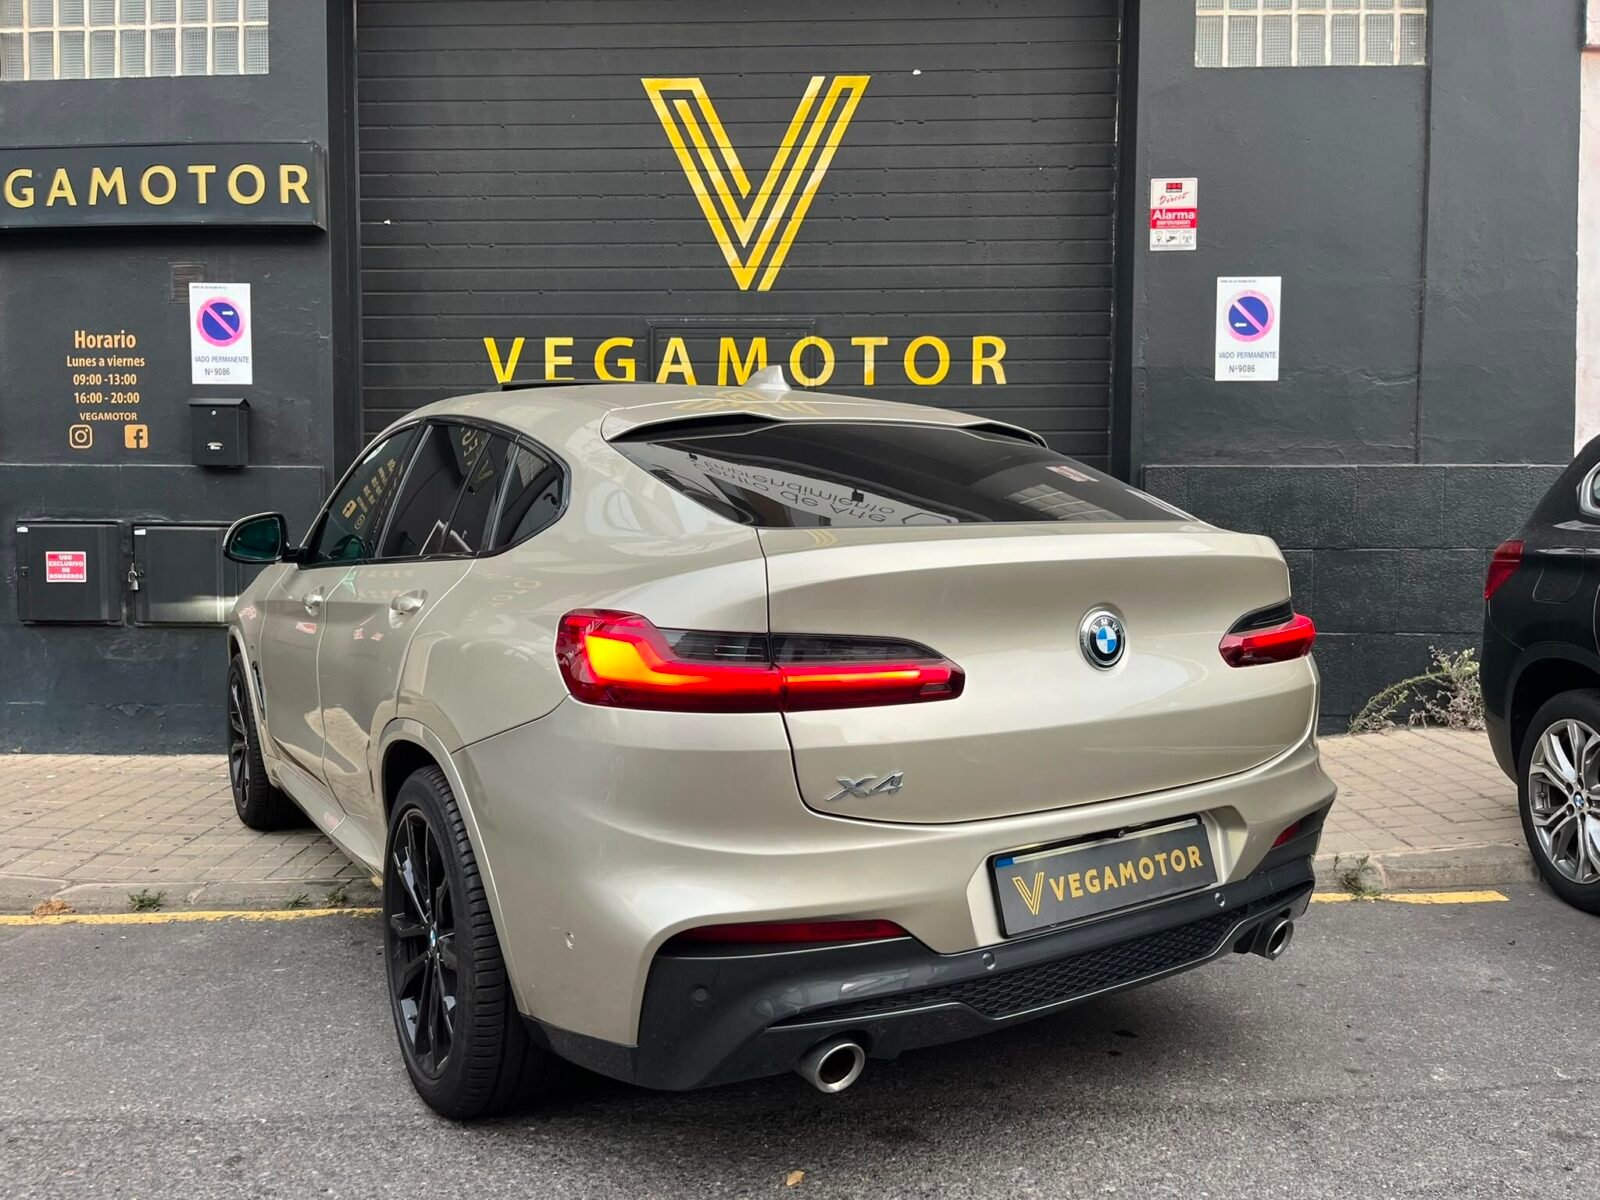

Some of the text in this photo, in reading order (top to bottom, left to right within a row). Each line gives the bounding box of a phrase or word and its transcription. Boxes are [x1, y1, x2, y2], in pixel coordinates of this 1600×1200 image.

[3, 164, 311, 208] GAMOTOR
[1152, 209, 1195, 220] Alarma
[74, 329, 137, 349] Horario
[66, 354, 146, 368] Lunes a viernes
[195, 355, 250, 364] VADO PERMANENTE
[483, 335, 1008, 387] VEGAMOTOR
[1218, 351, 1277, 359] VADO PERMANENTE
[73, 373, 102, 386] 09:00
[74, 391, 103, 404] 16:00
[110, 391, 140, 404] 20:00
[79, 412, 138, 421] VEGAMOTOR
[825, 770, 904, 801] X4
[1049, 845, 1203, 902] VEGAMOTOR
